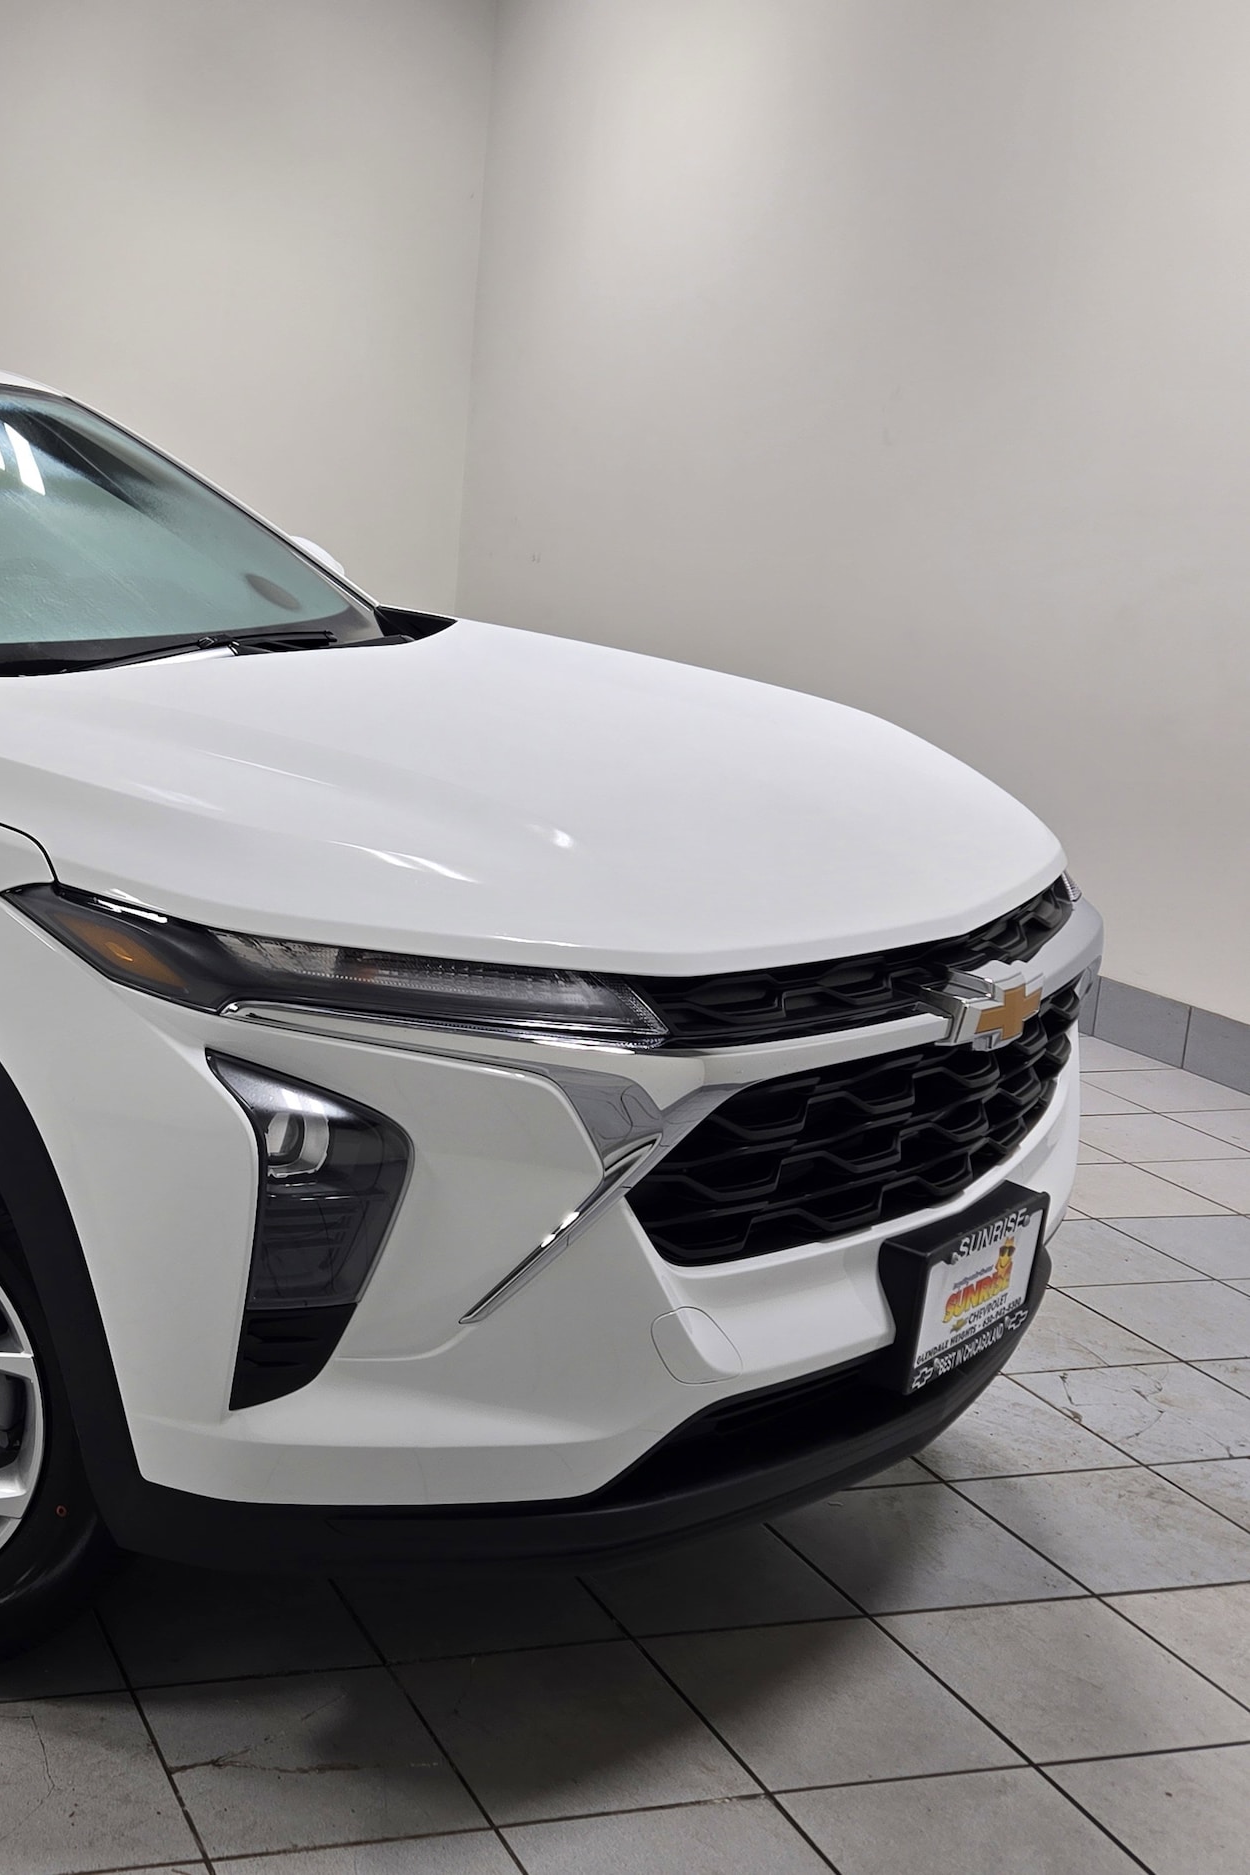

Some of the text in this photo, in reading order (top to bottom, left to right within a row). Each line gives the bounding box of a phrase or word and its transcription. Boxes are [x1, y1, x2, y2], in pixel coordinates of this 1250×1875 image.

[959, 1208, 1027, 1258] SUNRISE
[968, 1293, 1008, 1324] CHEVROLET
[917, 1339, 949, 1365] GLENDALE
[950, 1324, 976, 1345] HEIGHTS
[938, 1352, 956, 1375] BEST
